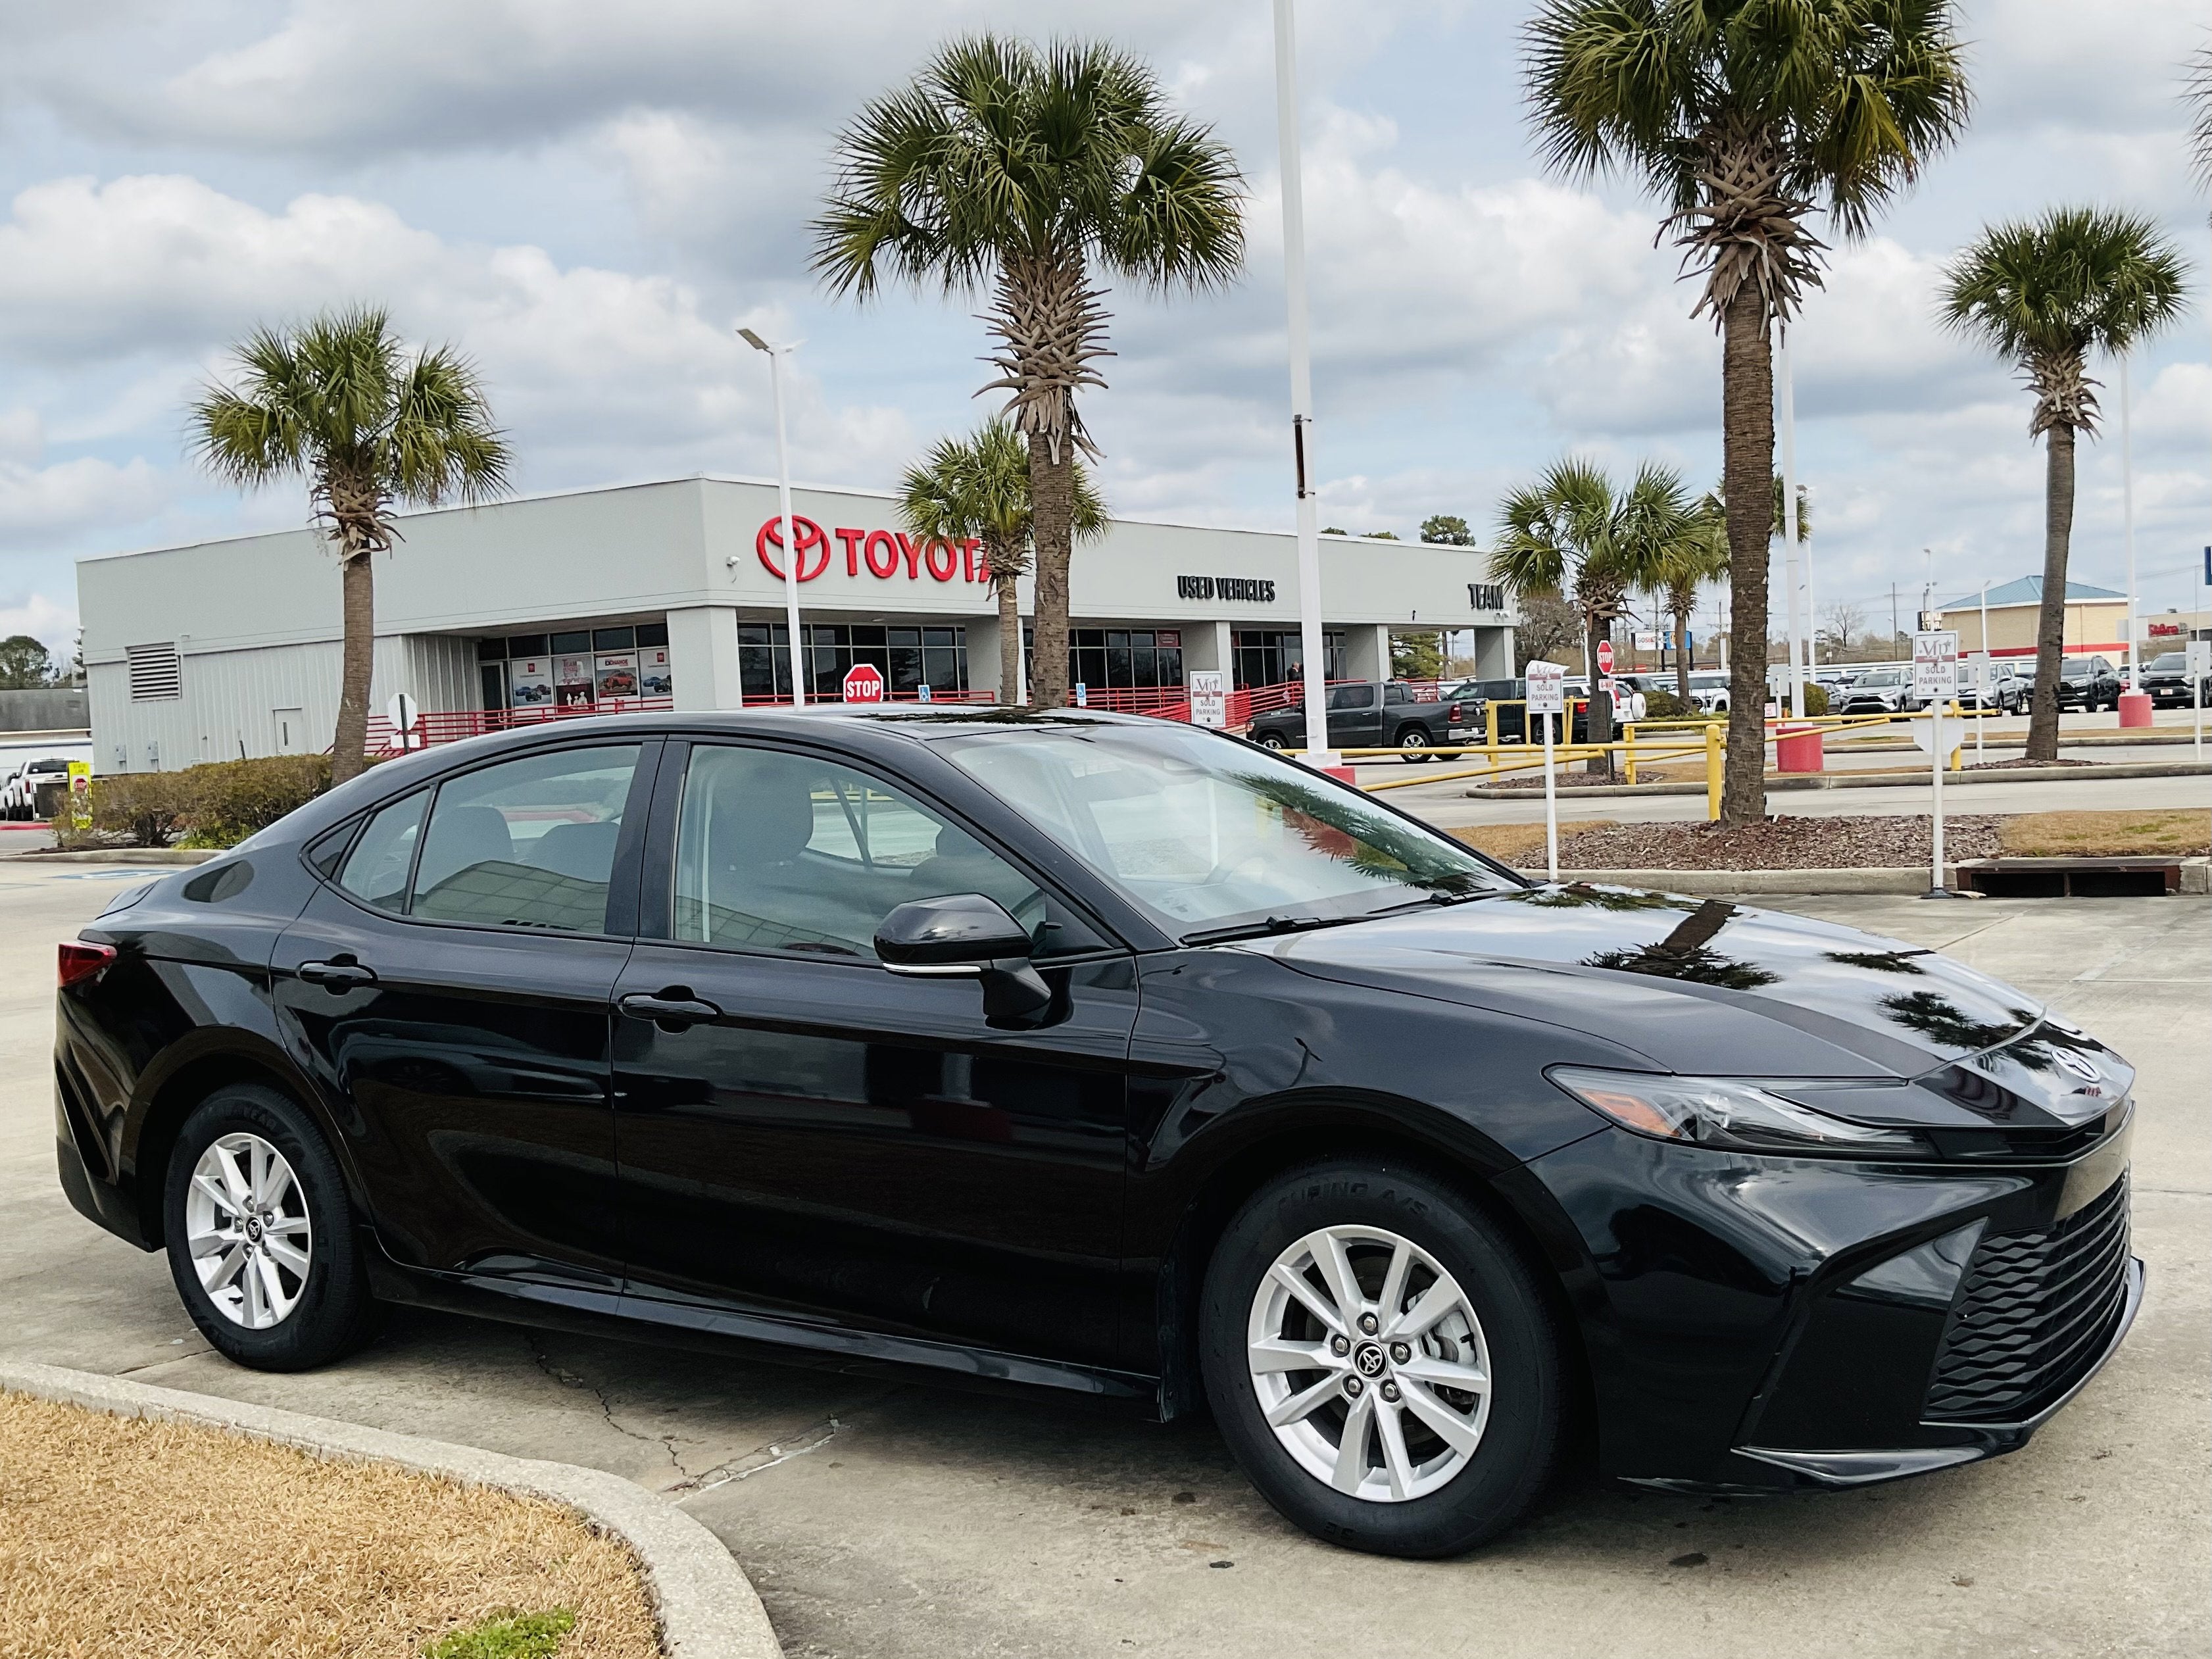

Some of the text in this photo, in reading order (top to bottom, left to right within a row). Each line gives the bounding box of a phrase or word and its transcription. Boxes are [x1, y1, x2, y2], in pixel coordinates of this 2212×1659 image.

[1177, 576, 1275, 601] USED VEHICLES
[1467, 583, 1504, 610] TEAM
[1598, 651, 1612, 663] STOP
[847, 680, 881, 697] STOP
[1919, 676, 1952, 685] PARKING
